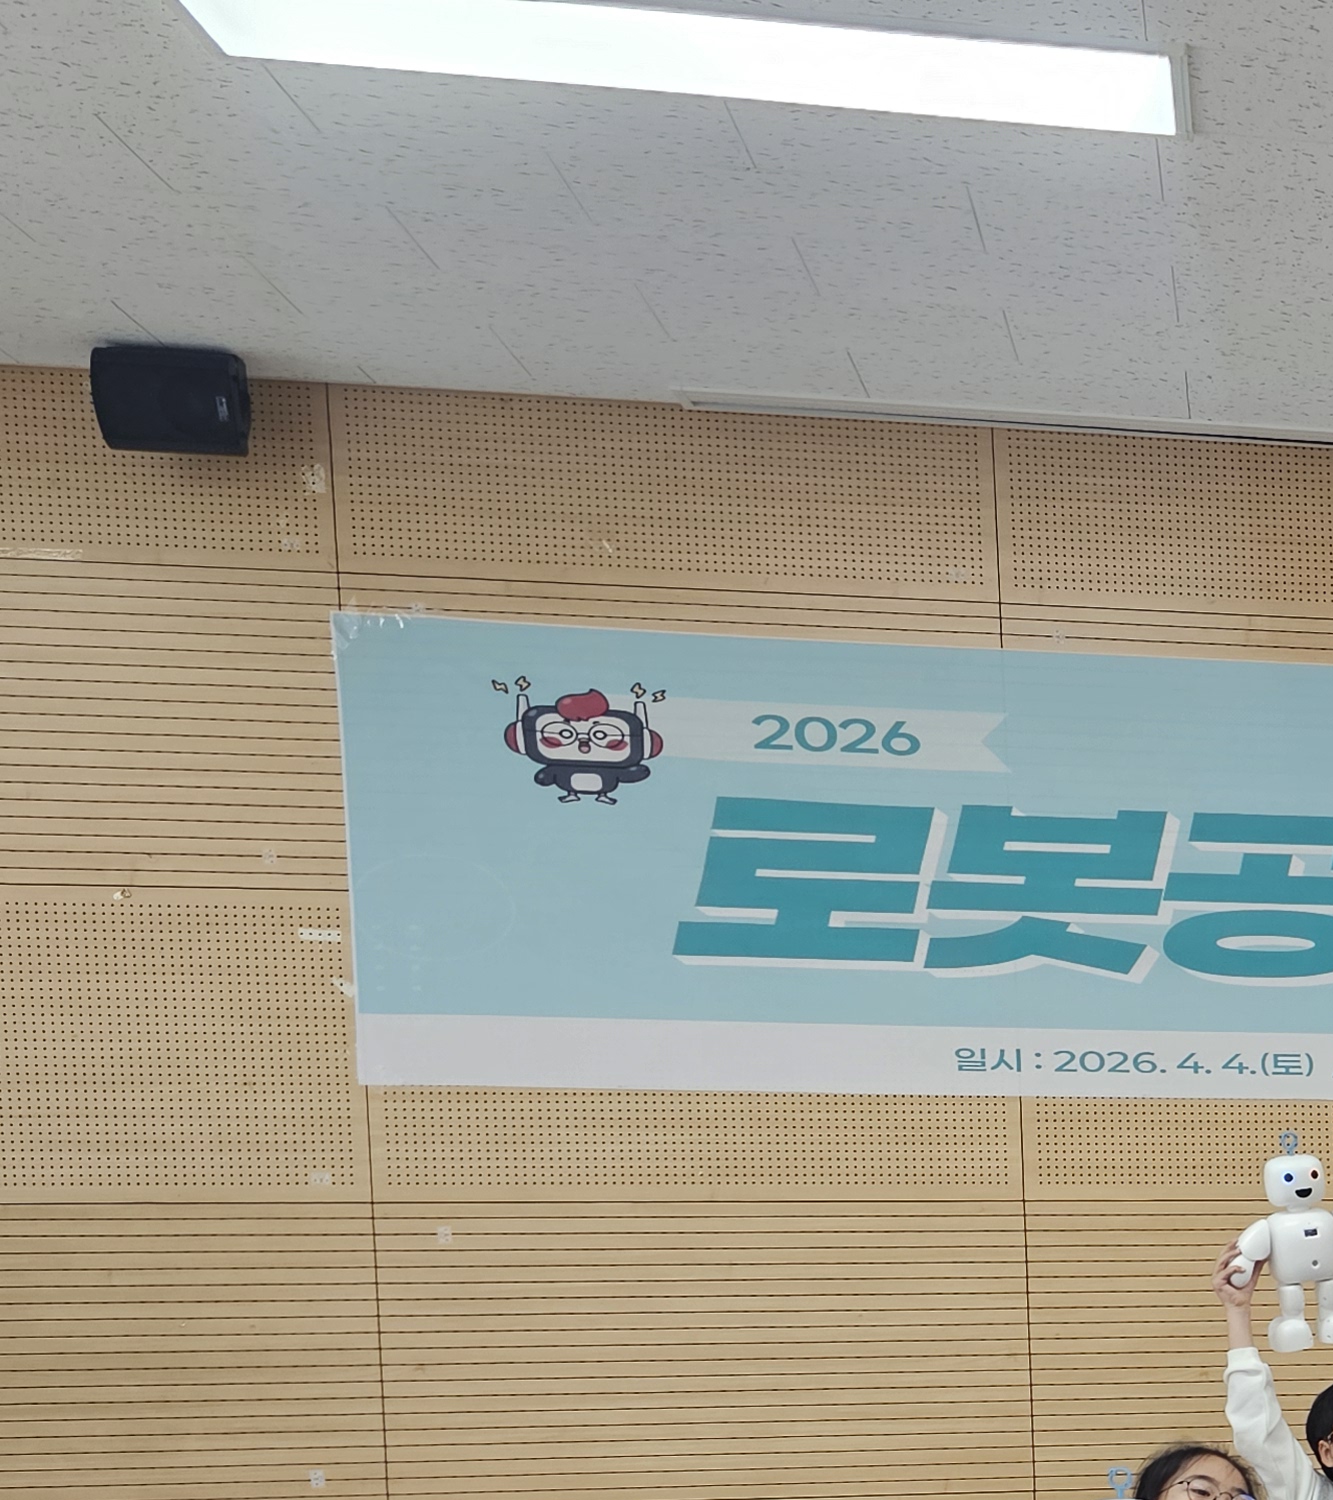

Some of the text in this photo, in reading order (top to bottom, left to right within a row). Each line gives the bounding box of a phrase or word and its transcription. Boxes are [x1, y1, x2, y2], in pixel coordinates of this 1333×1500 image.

[751, 712, 922, 758] 2026
[954, 1047, 1024, 1073] 일시
[1053, 1049, 1168, 1075] 2026.
[1176, 1052, 1213, 1075] 4.
[1221, 1052, 1315, 1078] 4.(토)
